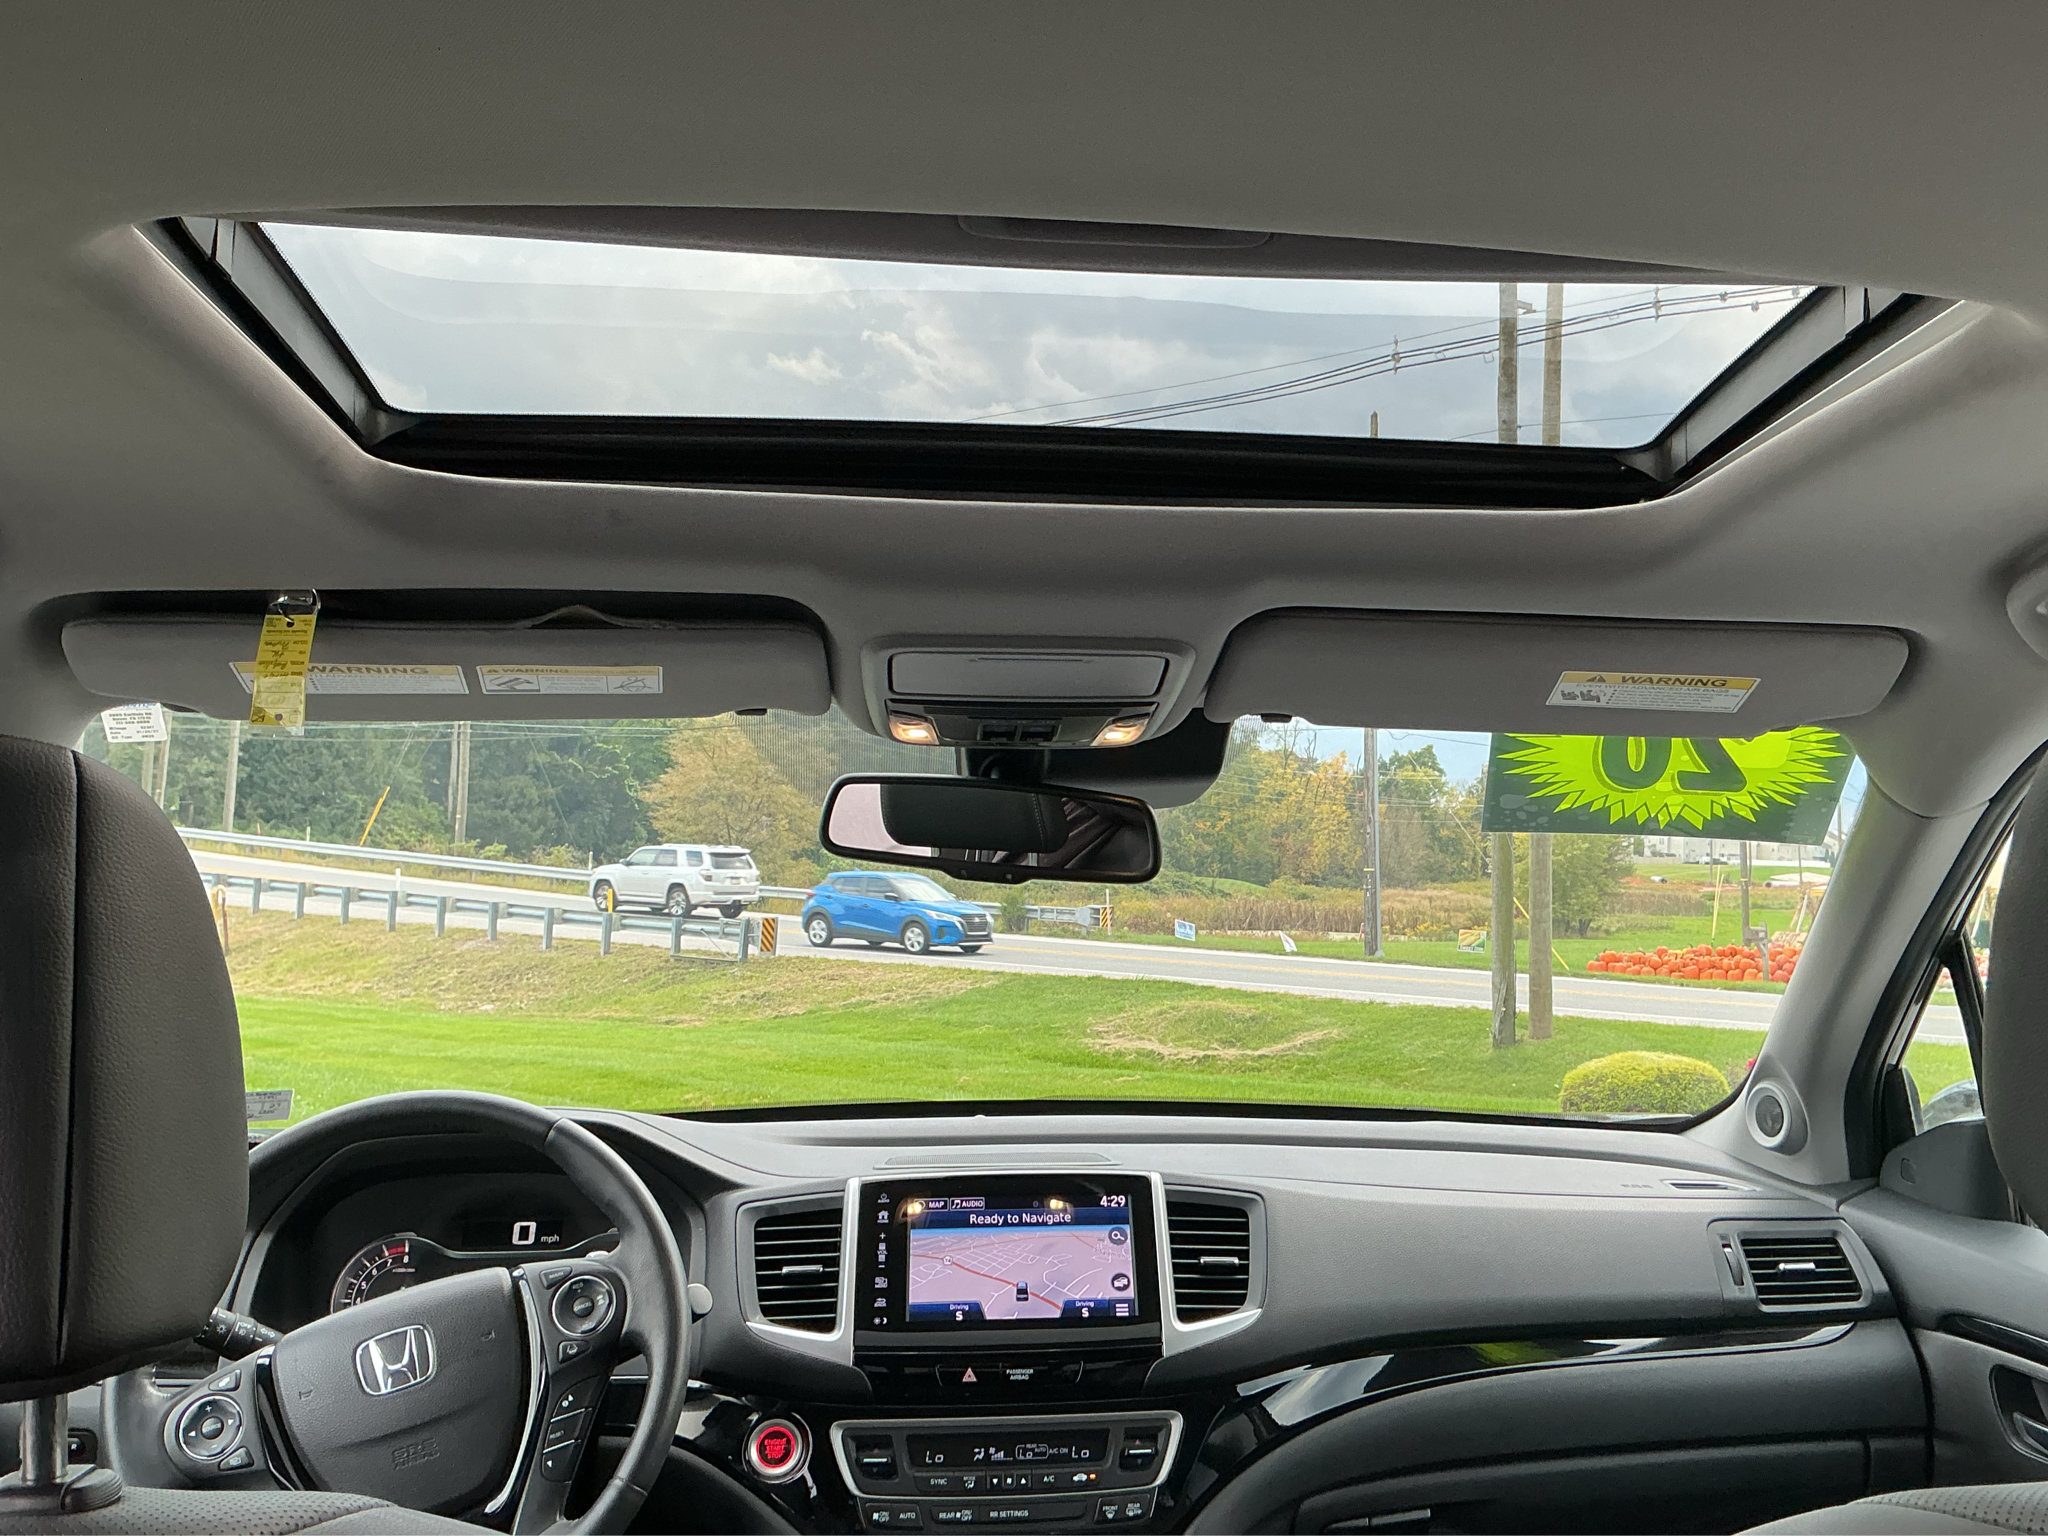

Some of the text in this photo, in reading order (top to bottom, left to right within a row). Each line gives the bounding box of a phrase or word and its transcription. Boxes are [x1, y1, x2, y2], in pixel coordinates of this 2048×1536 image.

[306, 664, 430, 675] WARNING
[1620, 675, 1728, 687] WARNING
[962, 1199, 984, 1208] AUDIO
[1100, 1195, 1126, 1207] 4:29
[969, 1212, 1071, 1226] Ready to Navigate
[512, 1221, 560, 1245] 0 mph
[386, 1258, 393, 1266] 7
[403, 1255, 409, 1263] 8
[925, 1450, 944, 1463] Lo
[1019, 1449, 1033, 1459] Lo
[1071, 1446, 1090, 1458] Lo
